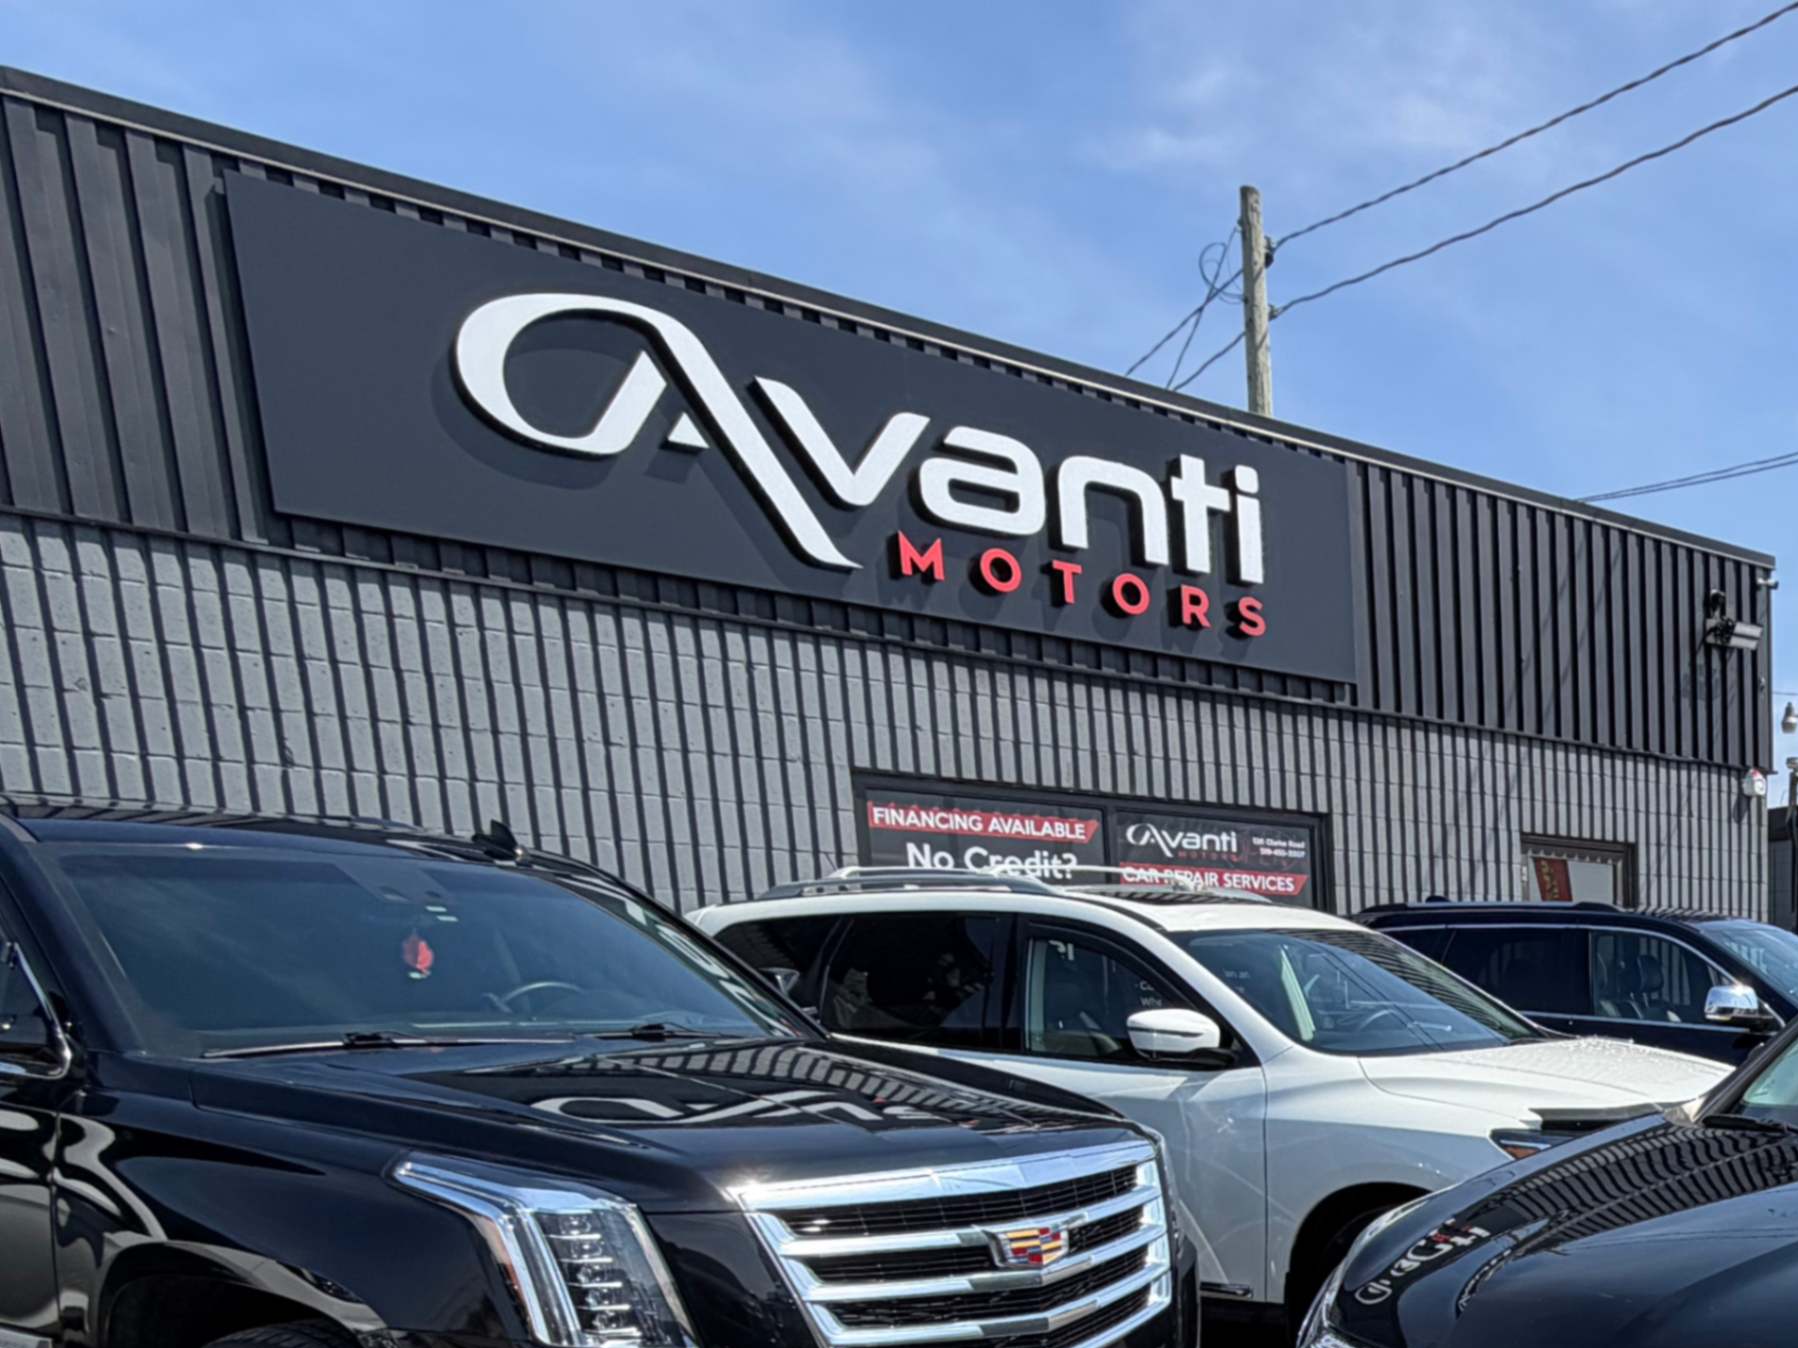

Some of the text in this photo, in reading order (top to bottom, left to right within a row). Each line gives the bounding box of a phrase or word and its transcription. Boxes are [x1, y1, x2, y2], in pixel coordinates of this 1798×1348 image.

[456, 293, 1264, 583] Avanti
[898, 530, 1267, 638] MOTORS
[872, 806, 1086, 840] FINANCING AVAILABLE
[1126, 823, 1238, 858] Avanti
[906, 842, 1077, 879] No Credit?
[1223, 873, 1294, 892] SERVICES
